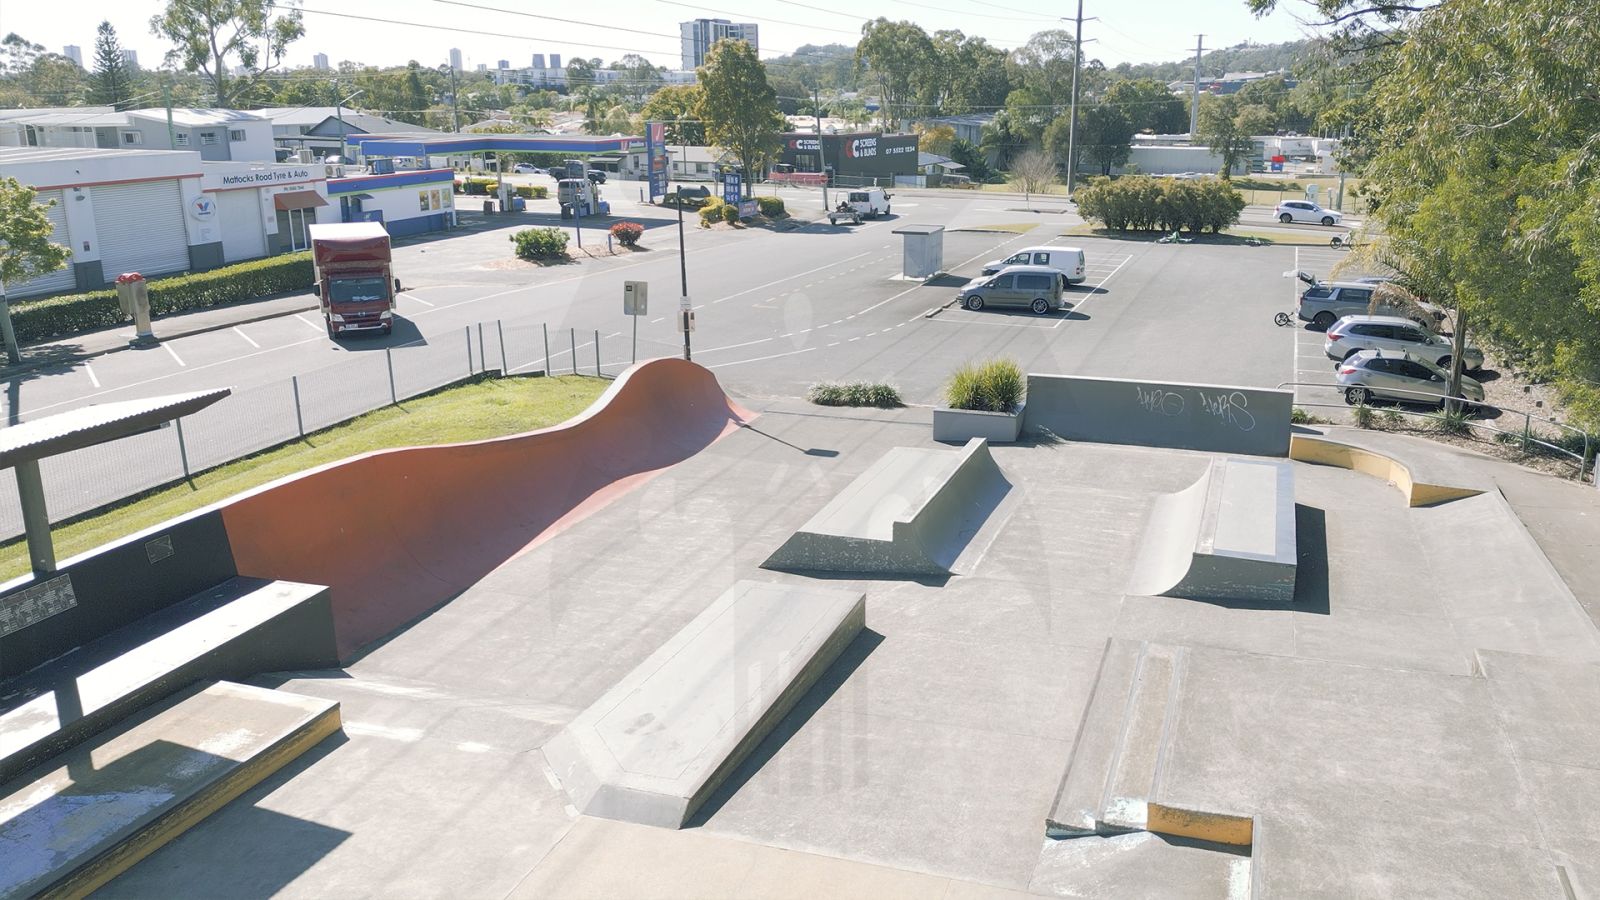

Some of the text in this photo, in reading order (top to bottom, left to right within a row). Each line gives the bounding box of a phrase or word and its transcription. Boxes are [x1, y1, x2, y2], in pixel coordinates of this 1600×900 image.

[860, 138, 877, 147] SCREENS
[864, 148, 877, 157] BLINDS
[223, 175, 254, 185] Mattocks
[255, 172, 272, 181] Road
[273, 171, 286, 182] Tyre
[294, 170, 308, 178] Auto
